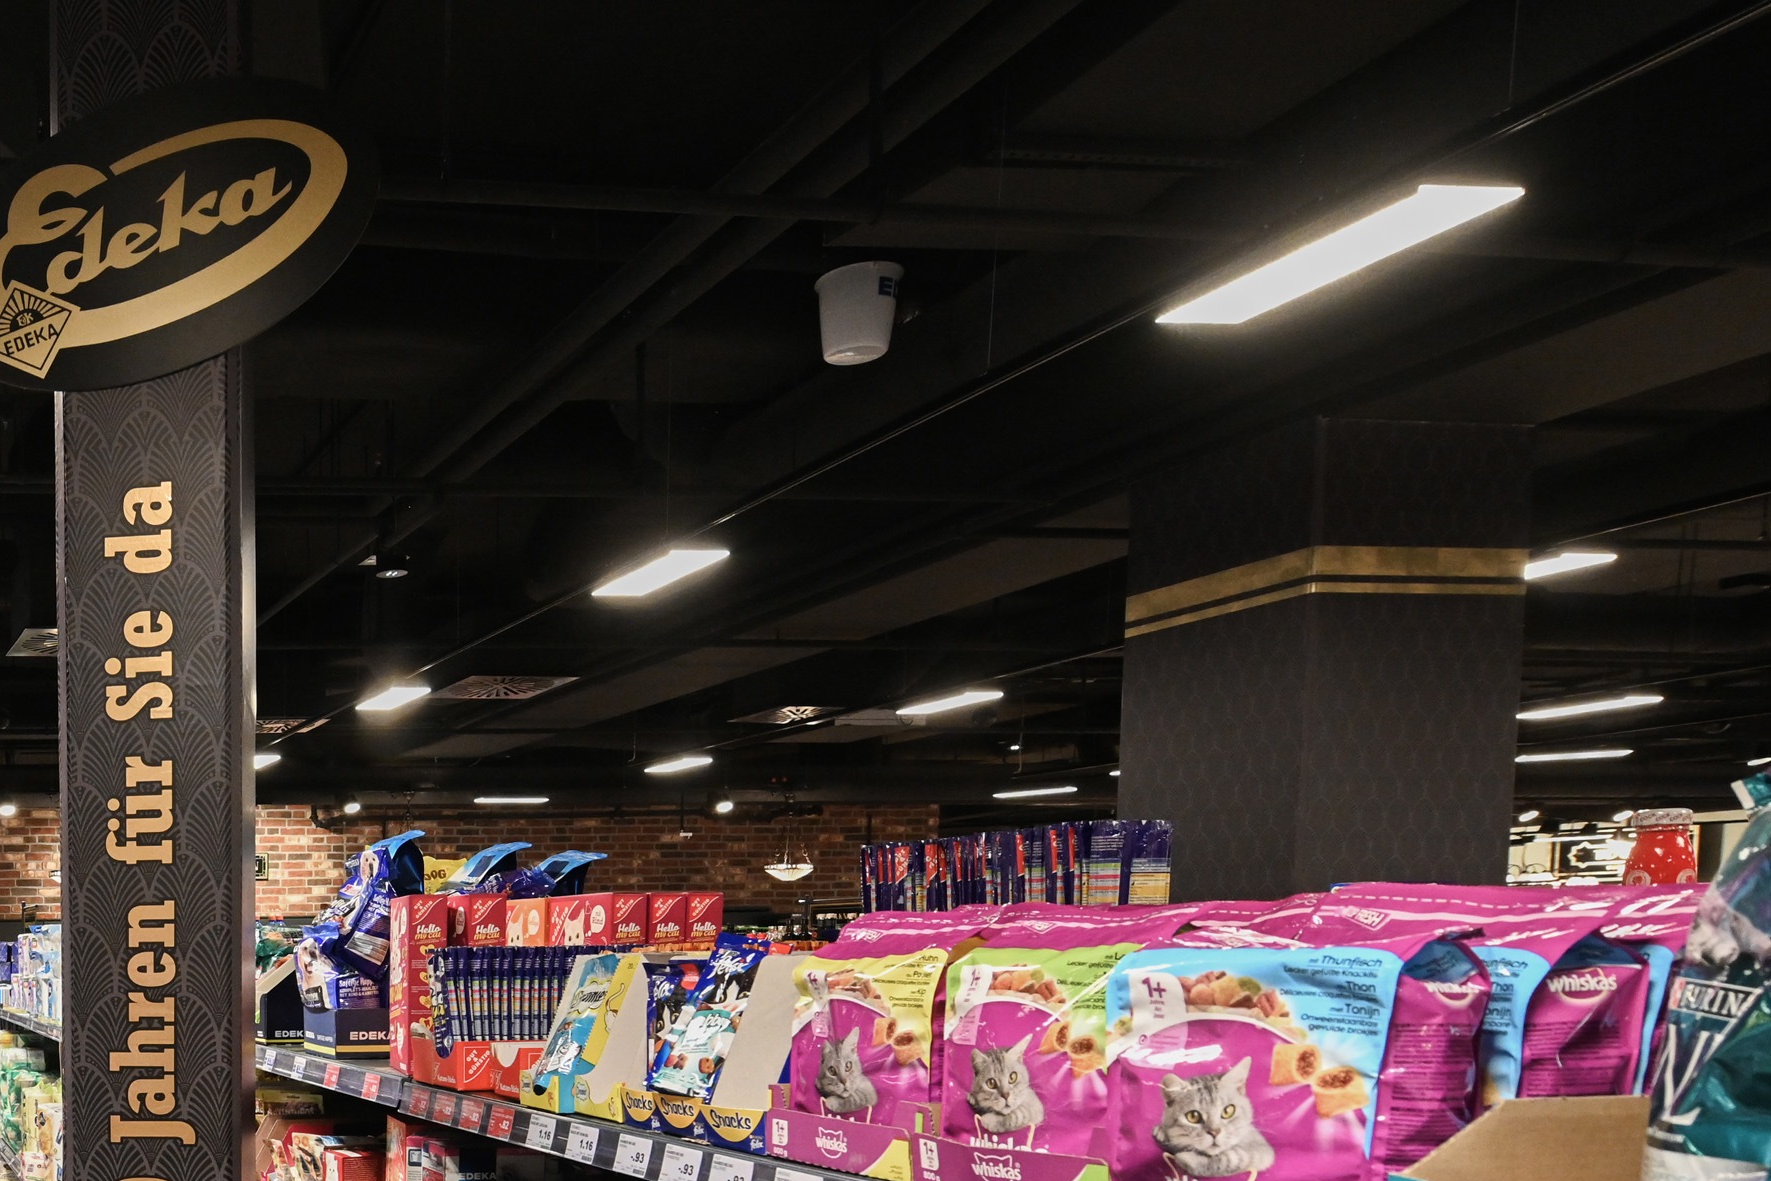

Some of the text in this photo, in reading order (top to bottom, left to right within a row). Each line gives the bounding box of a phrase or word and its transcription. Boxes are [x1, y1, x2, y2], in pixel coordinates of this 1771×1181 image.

[3, 323, 60, 357] EDEKA
[104, 481, 173, 574] da
[104, 609, 173, 722] Sie
[105, 756, 173, 866] für
[1321, 955, 1383, 968] Thunfisch
[1141, 977, 1167, 999] 1+
[1345, 981, 1376, 993] Thon
[1547, 974, 1617, 993] whiskas
[1345, 1003, 1381, 1018] Tonijn
[109, 899, 197, 1146] Jahren
[626, 1094, 653, 1111] Snacks
[661, 1099, 695, 1118] Snacks
[710, 1109, 752, 1132] Snacks
[538, 1129, 551, 1142] 1.16
[816, 1136, 847, 1153] whiskas
[579, 1139, 593, 1152] 1.16
[630, 1152, 645, 1164] -.93
[459, 1172, 496, 1180] EDEKA
[972, 1160, 1022, 1181] whiskas
